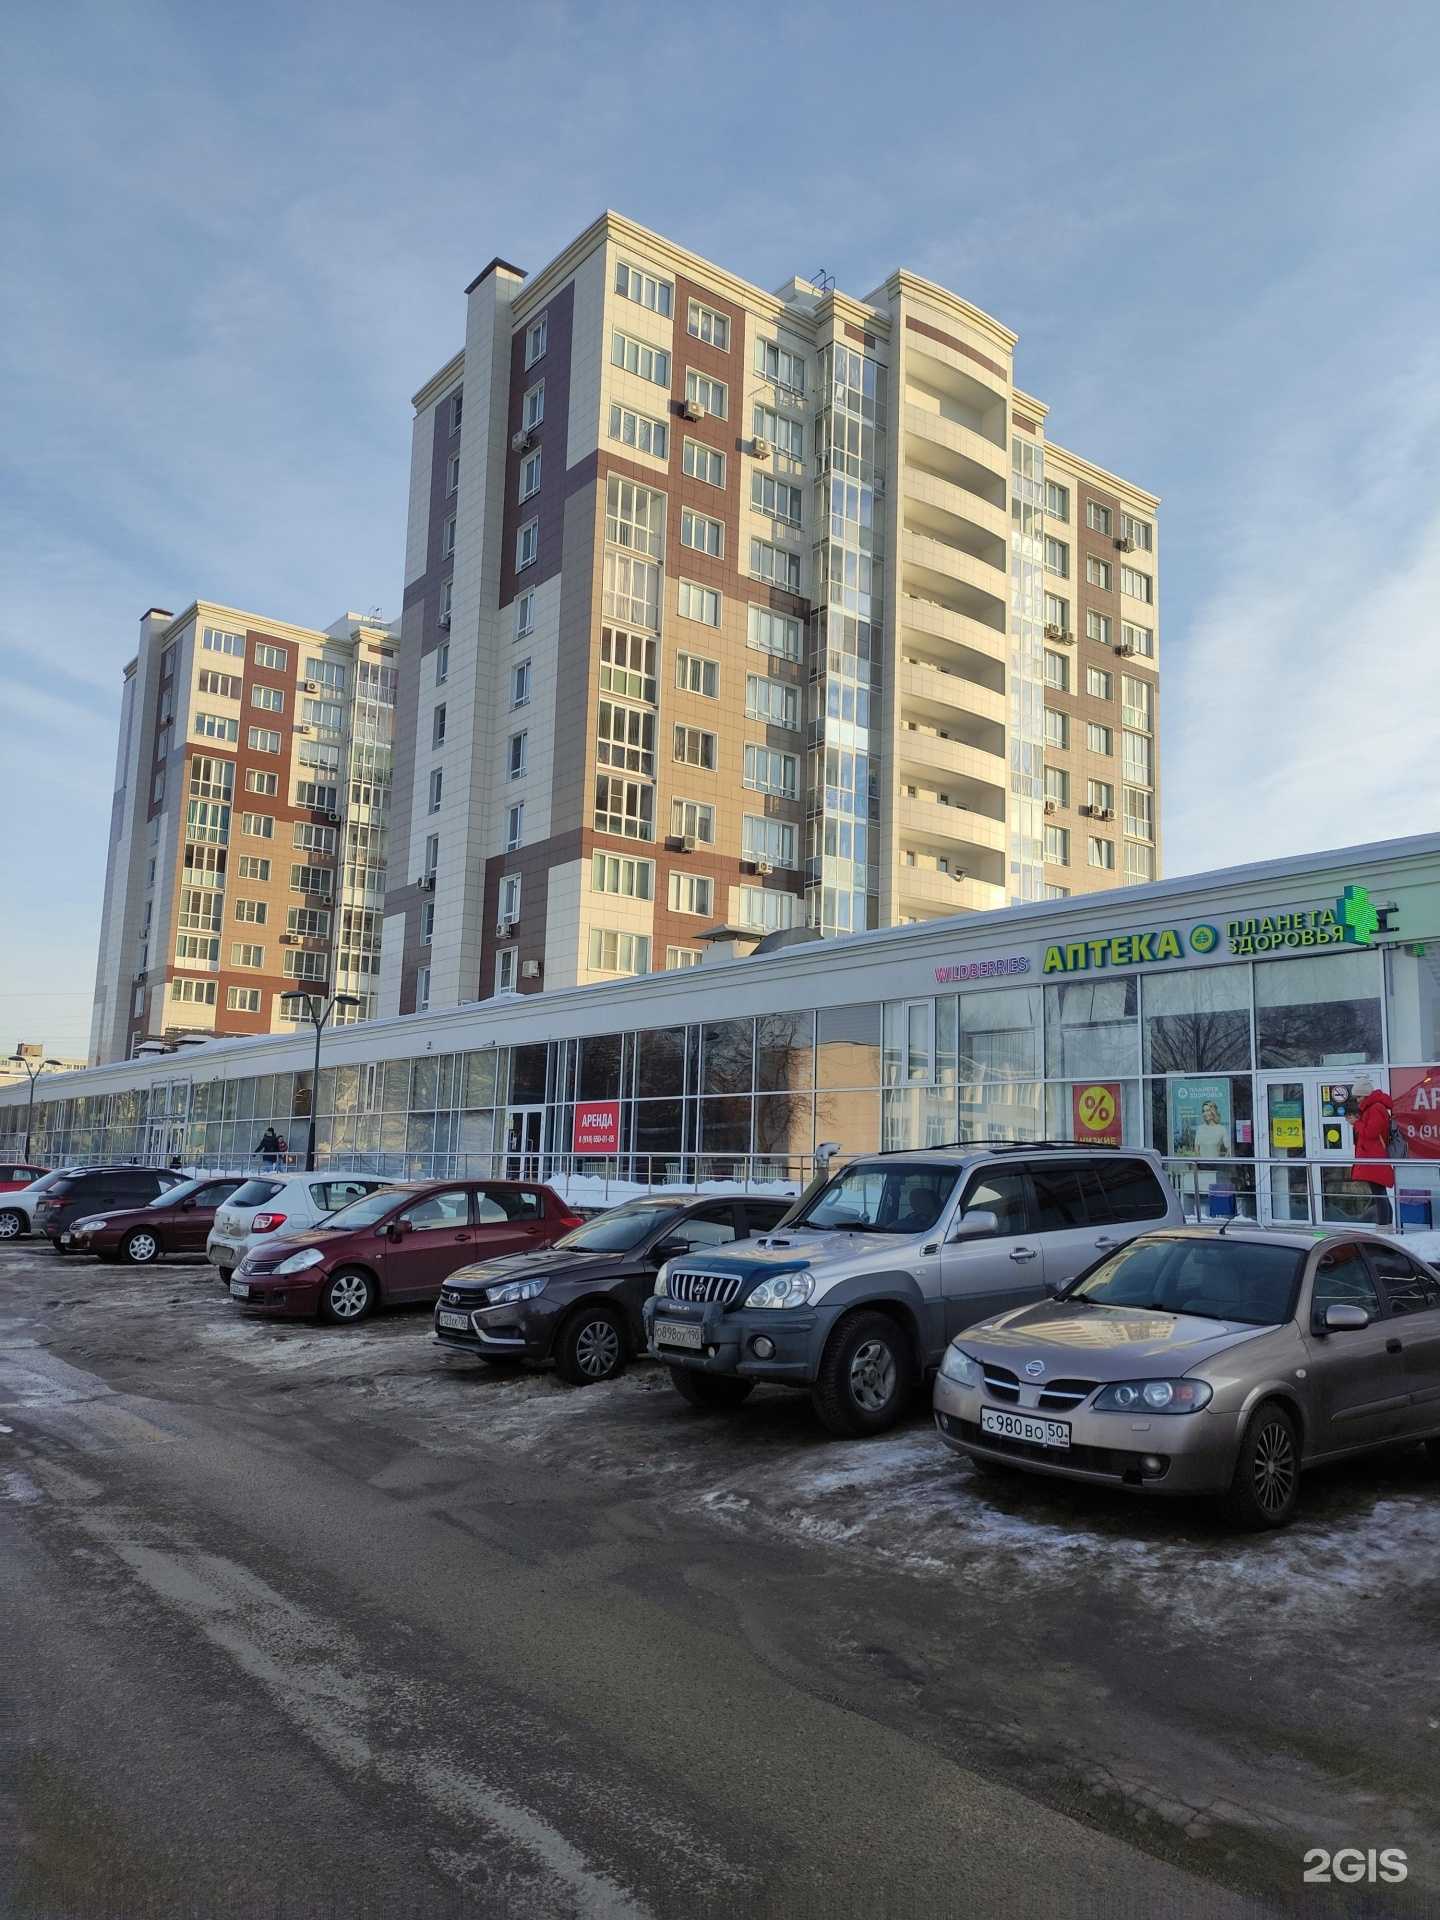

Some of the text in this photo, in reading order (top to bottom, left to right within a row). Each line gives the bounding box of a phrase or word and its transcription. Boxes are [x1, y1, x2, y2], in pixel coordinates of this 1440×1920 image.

[1227, 908, 1336, 937] ПЛАНЕТА
[1043, 929, 1184, 974] АПТЕКА
[1229, 925, 1344, 954] ЗДОРОВЬЯ
[934, 956, 1028, 983] WILDBERRIES
[582, 1113, 613, 1129] АРЕНДА
[1085, 1095, 1109, 1121] %
[1407, 1124, 1440, 1139] 8 (91
[1047, 1423, 1064, 1438] 50
